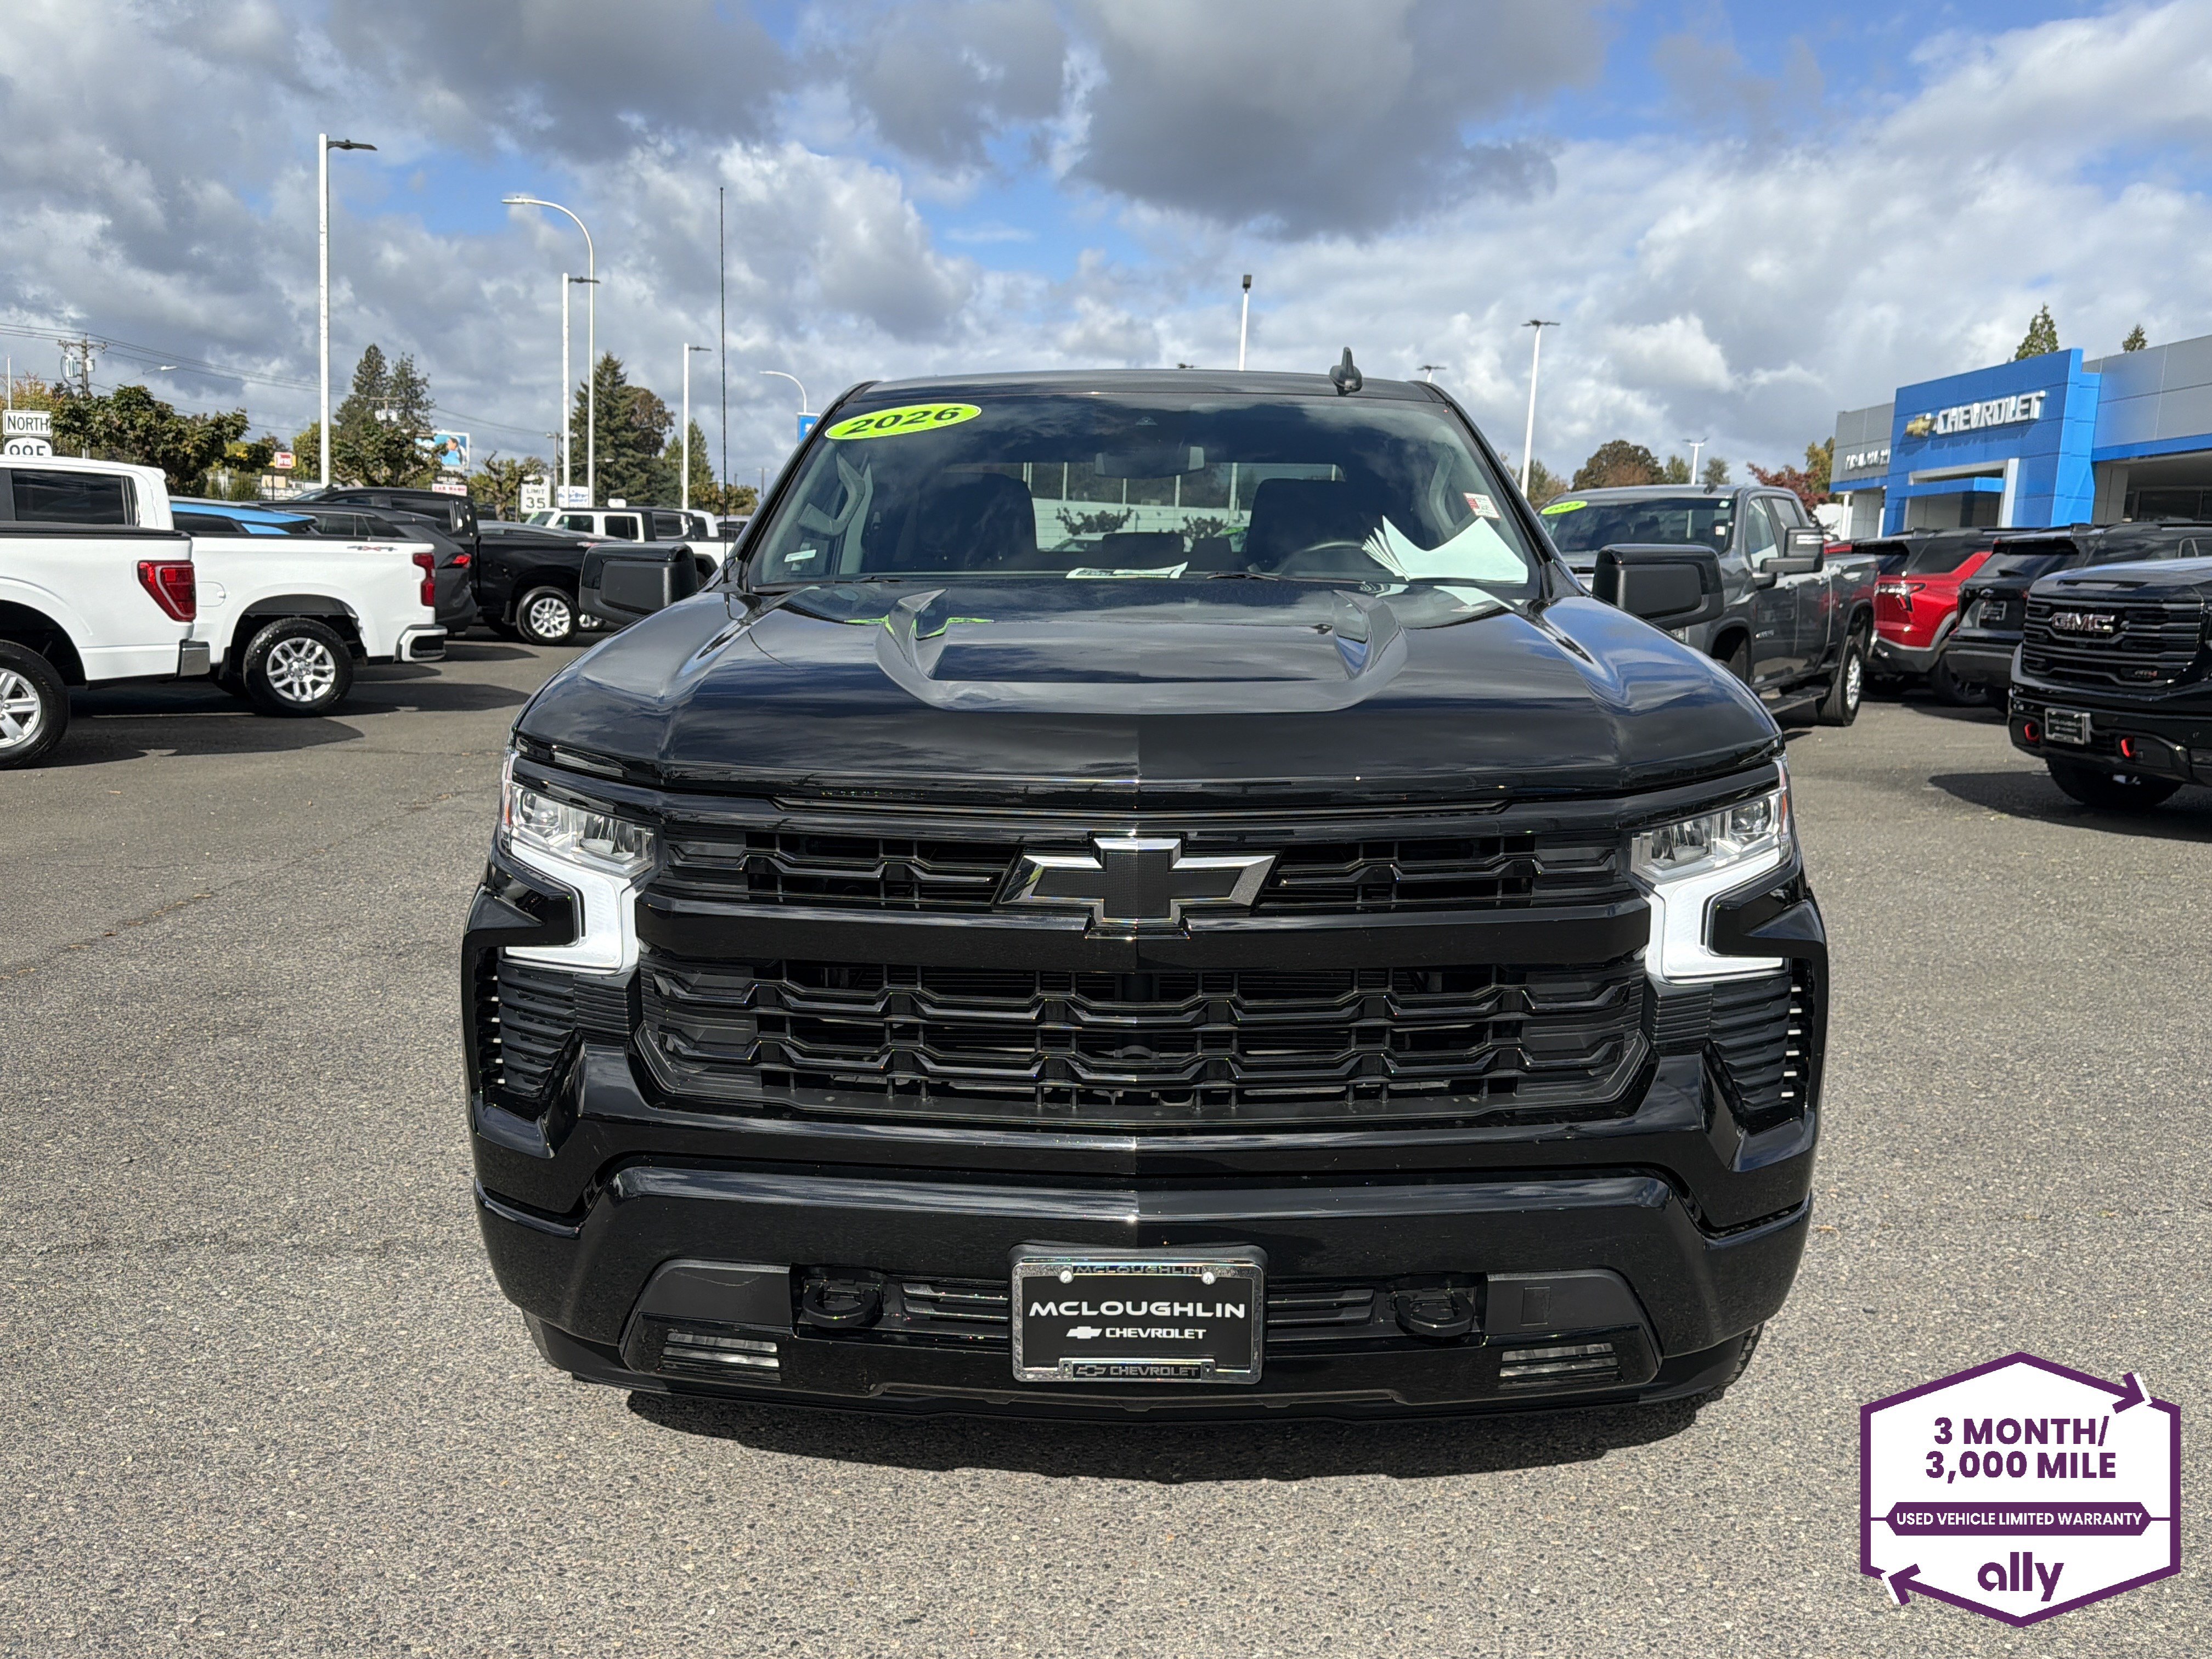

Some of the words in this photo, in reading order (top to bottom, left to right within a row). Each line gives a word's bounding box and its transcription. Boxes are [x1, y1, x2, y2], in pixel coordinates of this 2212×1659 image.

[1937, 390, 2046, 435] CHEVROLET
[7, 415, 49, 431] NORTH
[842, 407, 963, 436] 2026
[526, 496, 546, 509] 35
[2051, 612, 2115, 633] GMC
[1076, 1266, 1201, 1274] MCLOUGHLIN
[1029, 1301, 1245, 1318] MCLOUGHLIN
[1105, 1327, 1207, 1340] CHEVROLET
[1110, 1366, 1199, 1377] CHEVROLET
